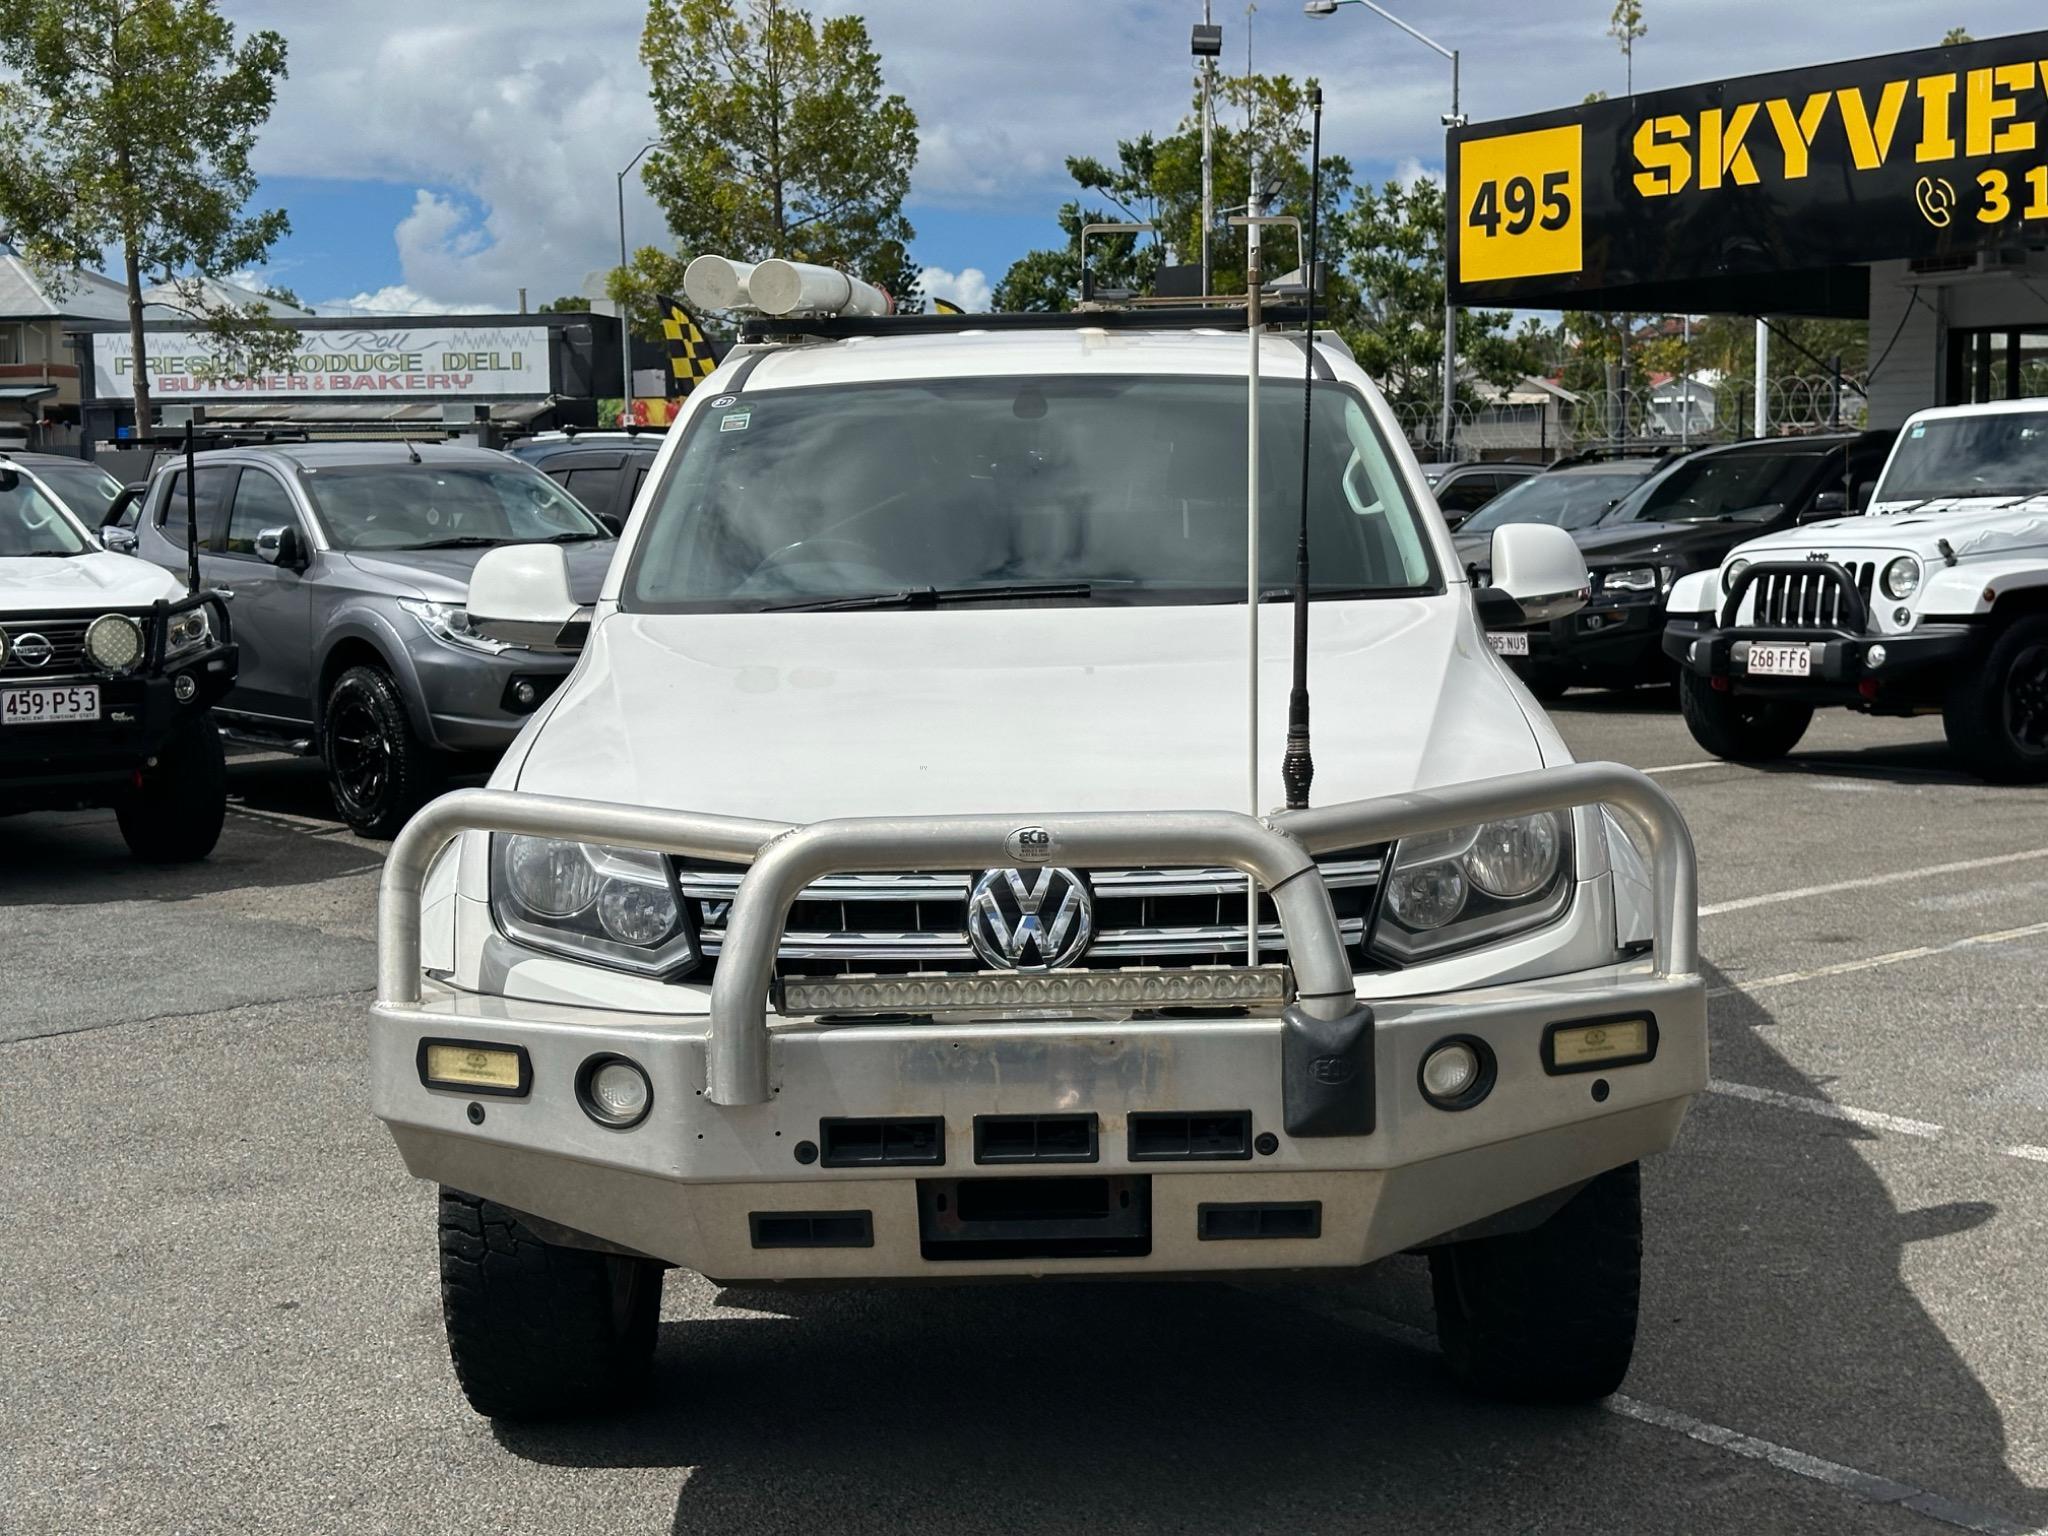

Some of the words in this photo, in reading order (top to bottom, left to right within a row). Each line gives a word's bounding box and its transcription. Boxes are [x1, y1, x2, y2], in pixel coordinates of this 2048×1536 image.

[1632, 59, 2048, 197] SKYVIE
[1469, 171, 1571, 238] 495
[1976, 164, 2048, 223] 31
[335, 330, 412, 351] Roll
[114, 354, 236, 376] FRESH
[442, 352, 522, 371] DELI
[158, 375, 308, 393] BUTCHER
[313, 376, 325, 391] &
[329, 374, 474, 390] BAKERY
[1019, 830, 1049, 844] ECB
[700, 901, 733, 925] V
